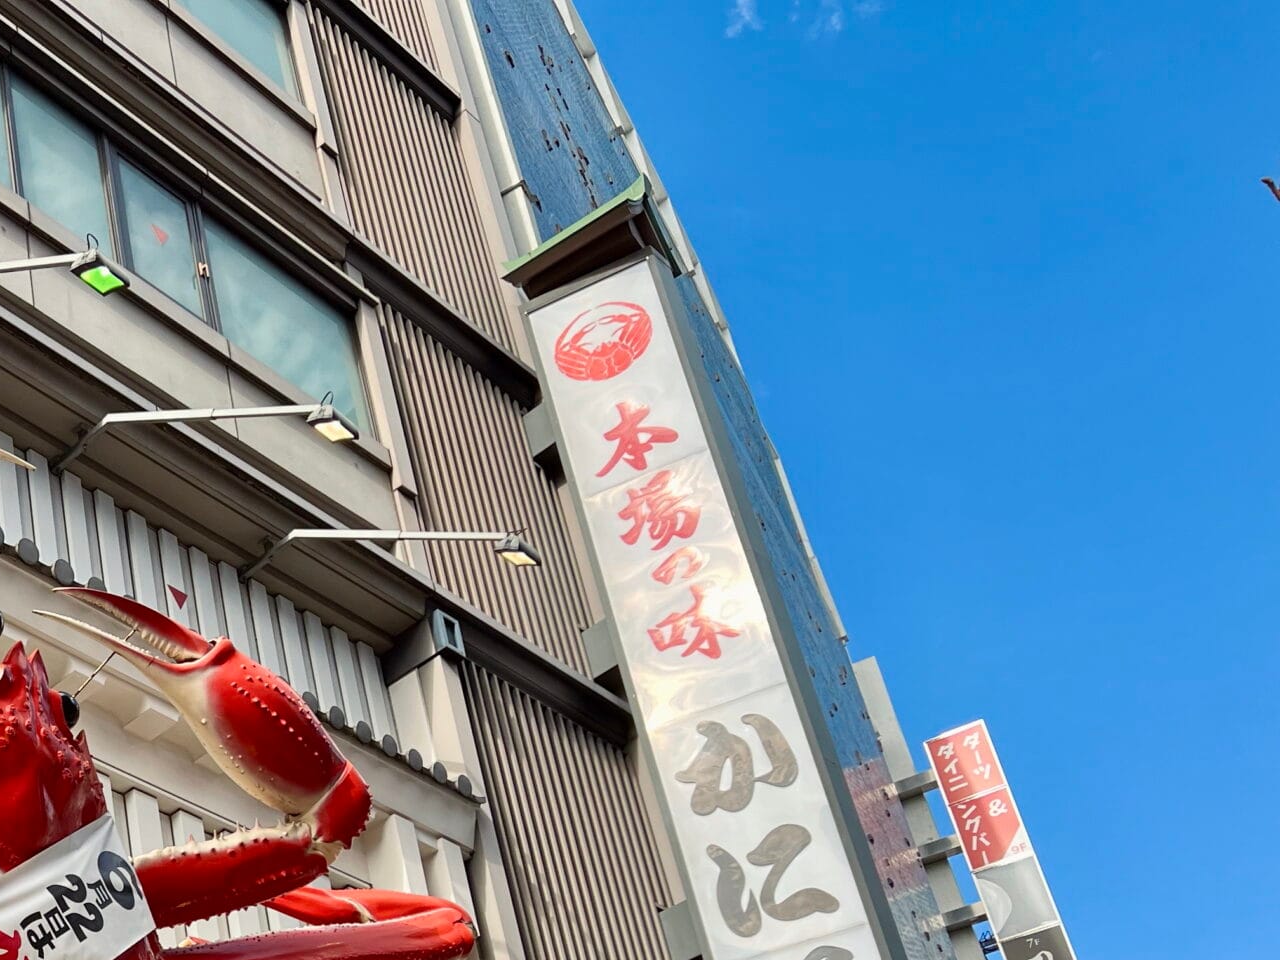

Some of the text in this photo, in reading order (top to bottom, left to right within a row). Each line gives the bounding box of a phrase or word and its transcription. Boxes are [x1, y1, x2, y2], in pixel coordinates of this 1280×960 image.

[595, 401, 741, 660] 本場の味
[936, 741, 991, 866] ダイニングバー
